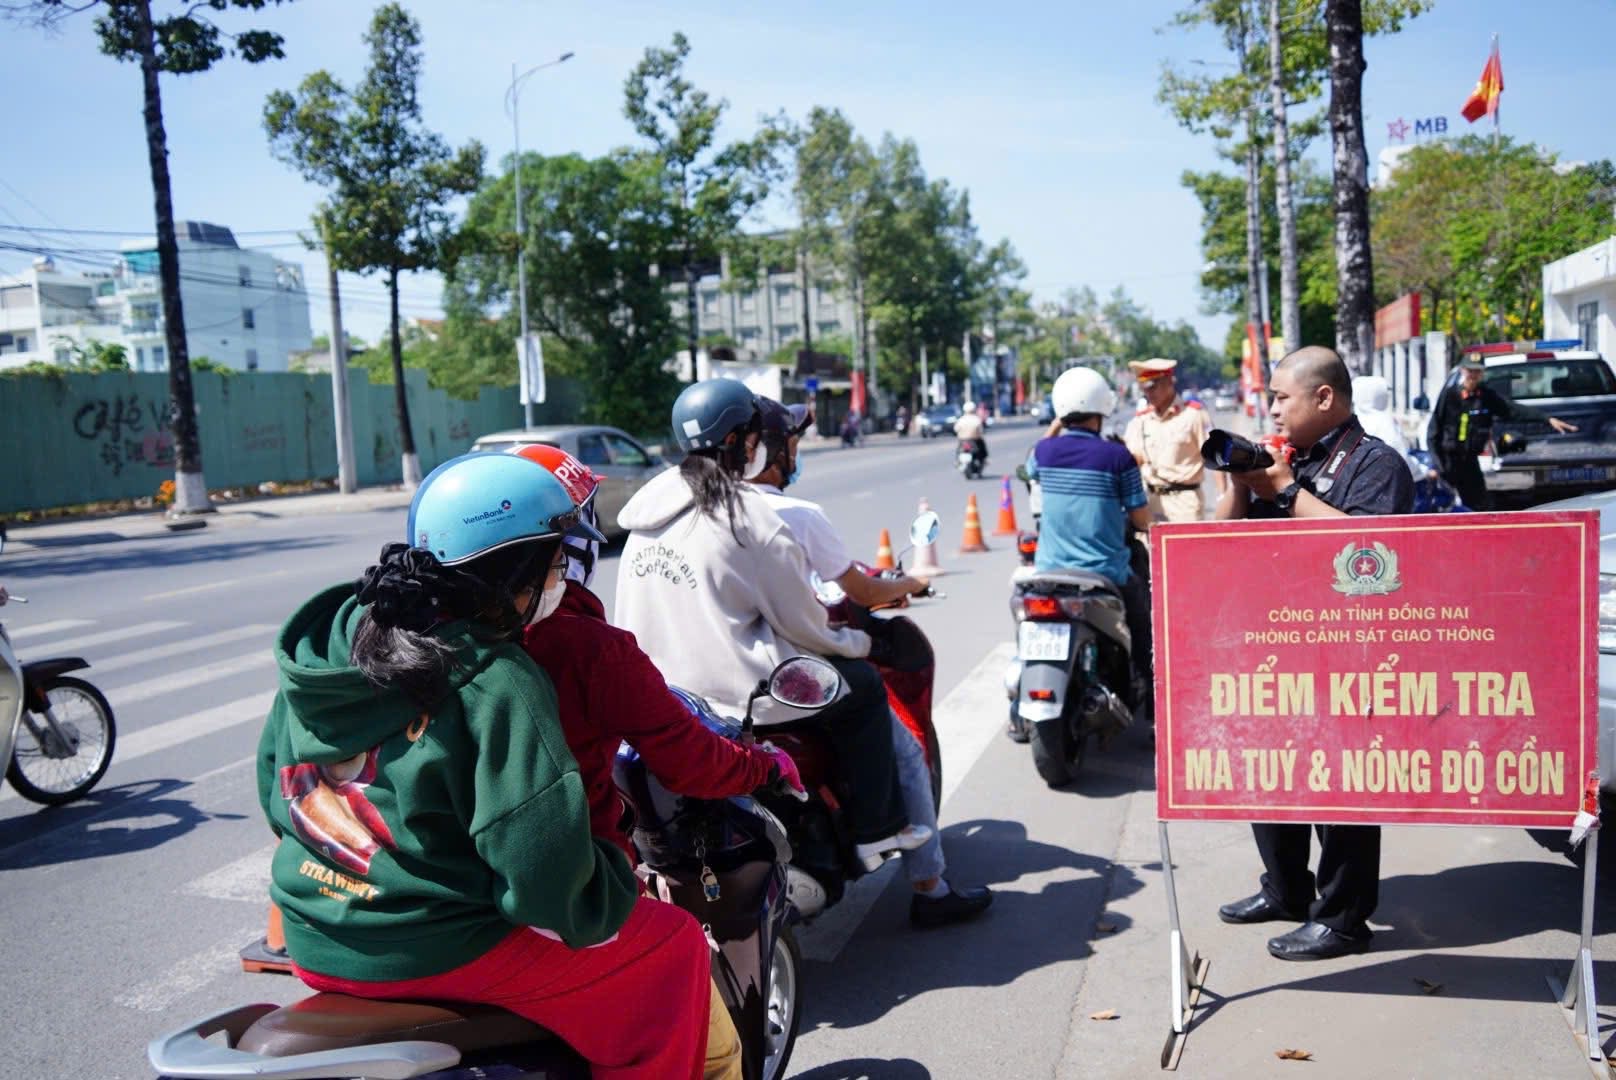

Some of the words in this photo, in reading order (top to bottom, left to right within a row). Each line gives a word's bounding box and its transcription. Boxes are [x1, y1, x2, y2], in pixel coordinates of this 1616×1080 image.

[1415, 116, 1448, 135] MB
[635, 558, 681, 585] Coffee
[1268, 605, 1315, 622] CÔNG
[1319, 608, 1341, 621] AN
[1345, 603, 1383, 621] TỈNH
[1388, 602, 1436, 621] ĐỒNG
[1441, 607, 1469, 620] NAI
[1245, 628, 1301, 644] PHÒNG
[1305, 625, 1350, 643] CẢNH
[1355, 626, 1387, 642] SÁT
[1391, 629, 1432, 642] GIAO
[1435, 625, 1495, 641] THÔNG
[1210, 655, 1315, 716] ĐIỂM
[1329, 653, 1438, 716] KIỂM
[1452, 671, 1536, 716] TRA
[1185, 748, 1233, 791] MA
[1241, 740, 1297, 792] TUÝ
[1308, 749, 1331, 792] &
[1342, 734, 1431, 793] NỒNG
[1441, 740, 1485, 804] ĐỘ
[1496, 735, 1565, 796] CỒN
